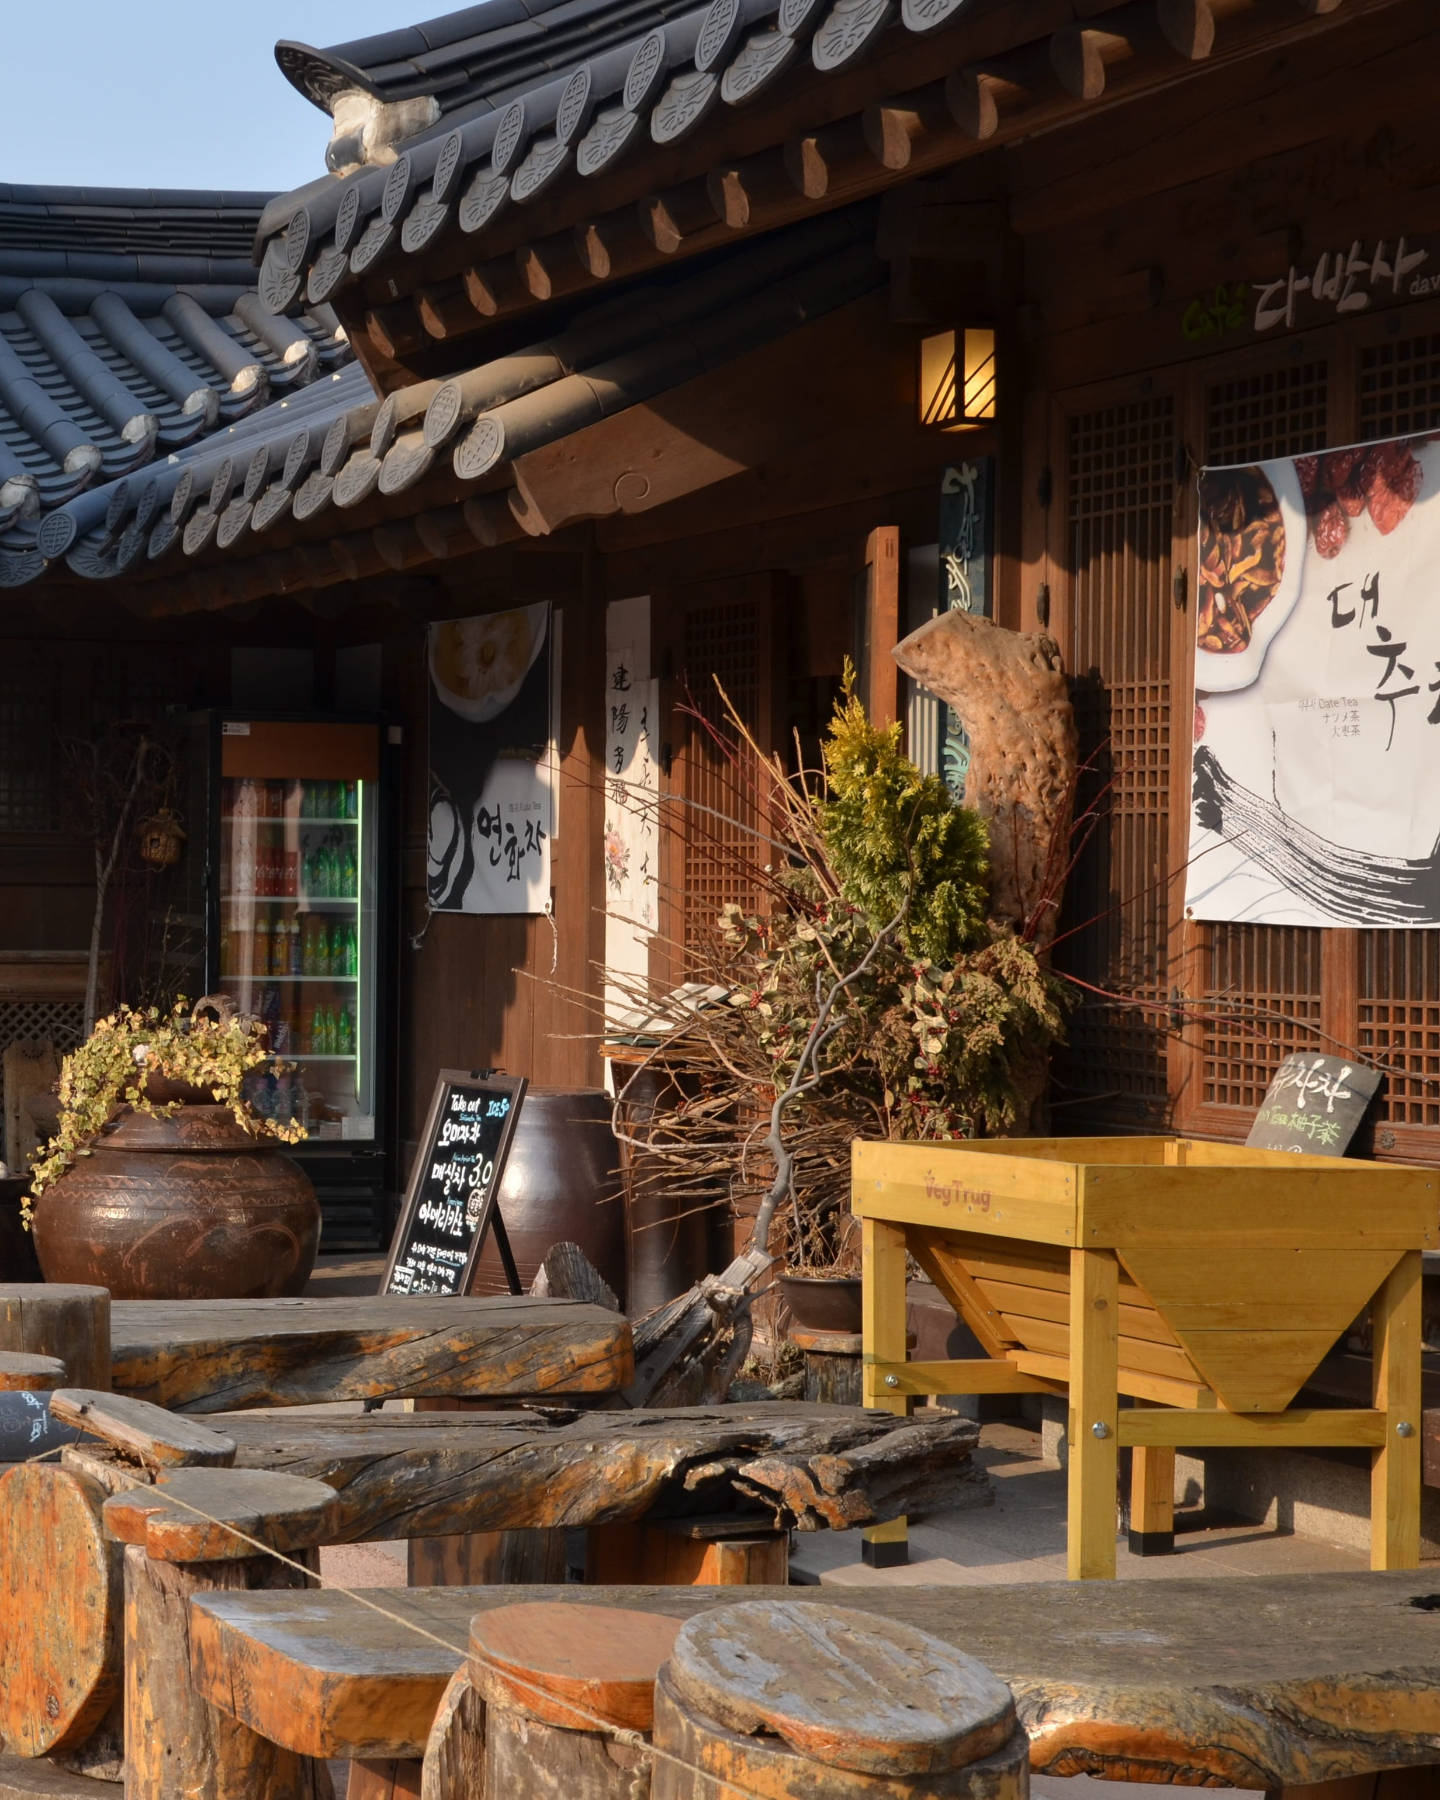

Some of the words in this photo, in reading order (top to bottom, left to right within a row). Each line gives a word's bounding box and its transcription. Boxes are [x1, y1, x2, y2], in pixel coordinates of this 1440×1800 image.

[1252, 236, 1428, 331] 다반사
[1326, 571, 1440, 751] 대추
[1342, 697, 1358, 707] Tea
[451, 1094, 467, 1113] Take
[467, 1096, 481, 1113] out
[438, 1118, 481, 1147] 오미자차
[431, 1161, 466, 1195] 매실차
[468, 1153, 493, 1187] 3.0
[925, 1180, 991, 1213] VegTrug
[419, 1199, 463, 1236] 아메리카노
[29, 1410, 48, 1443] Tea
